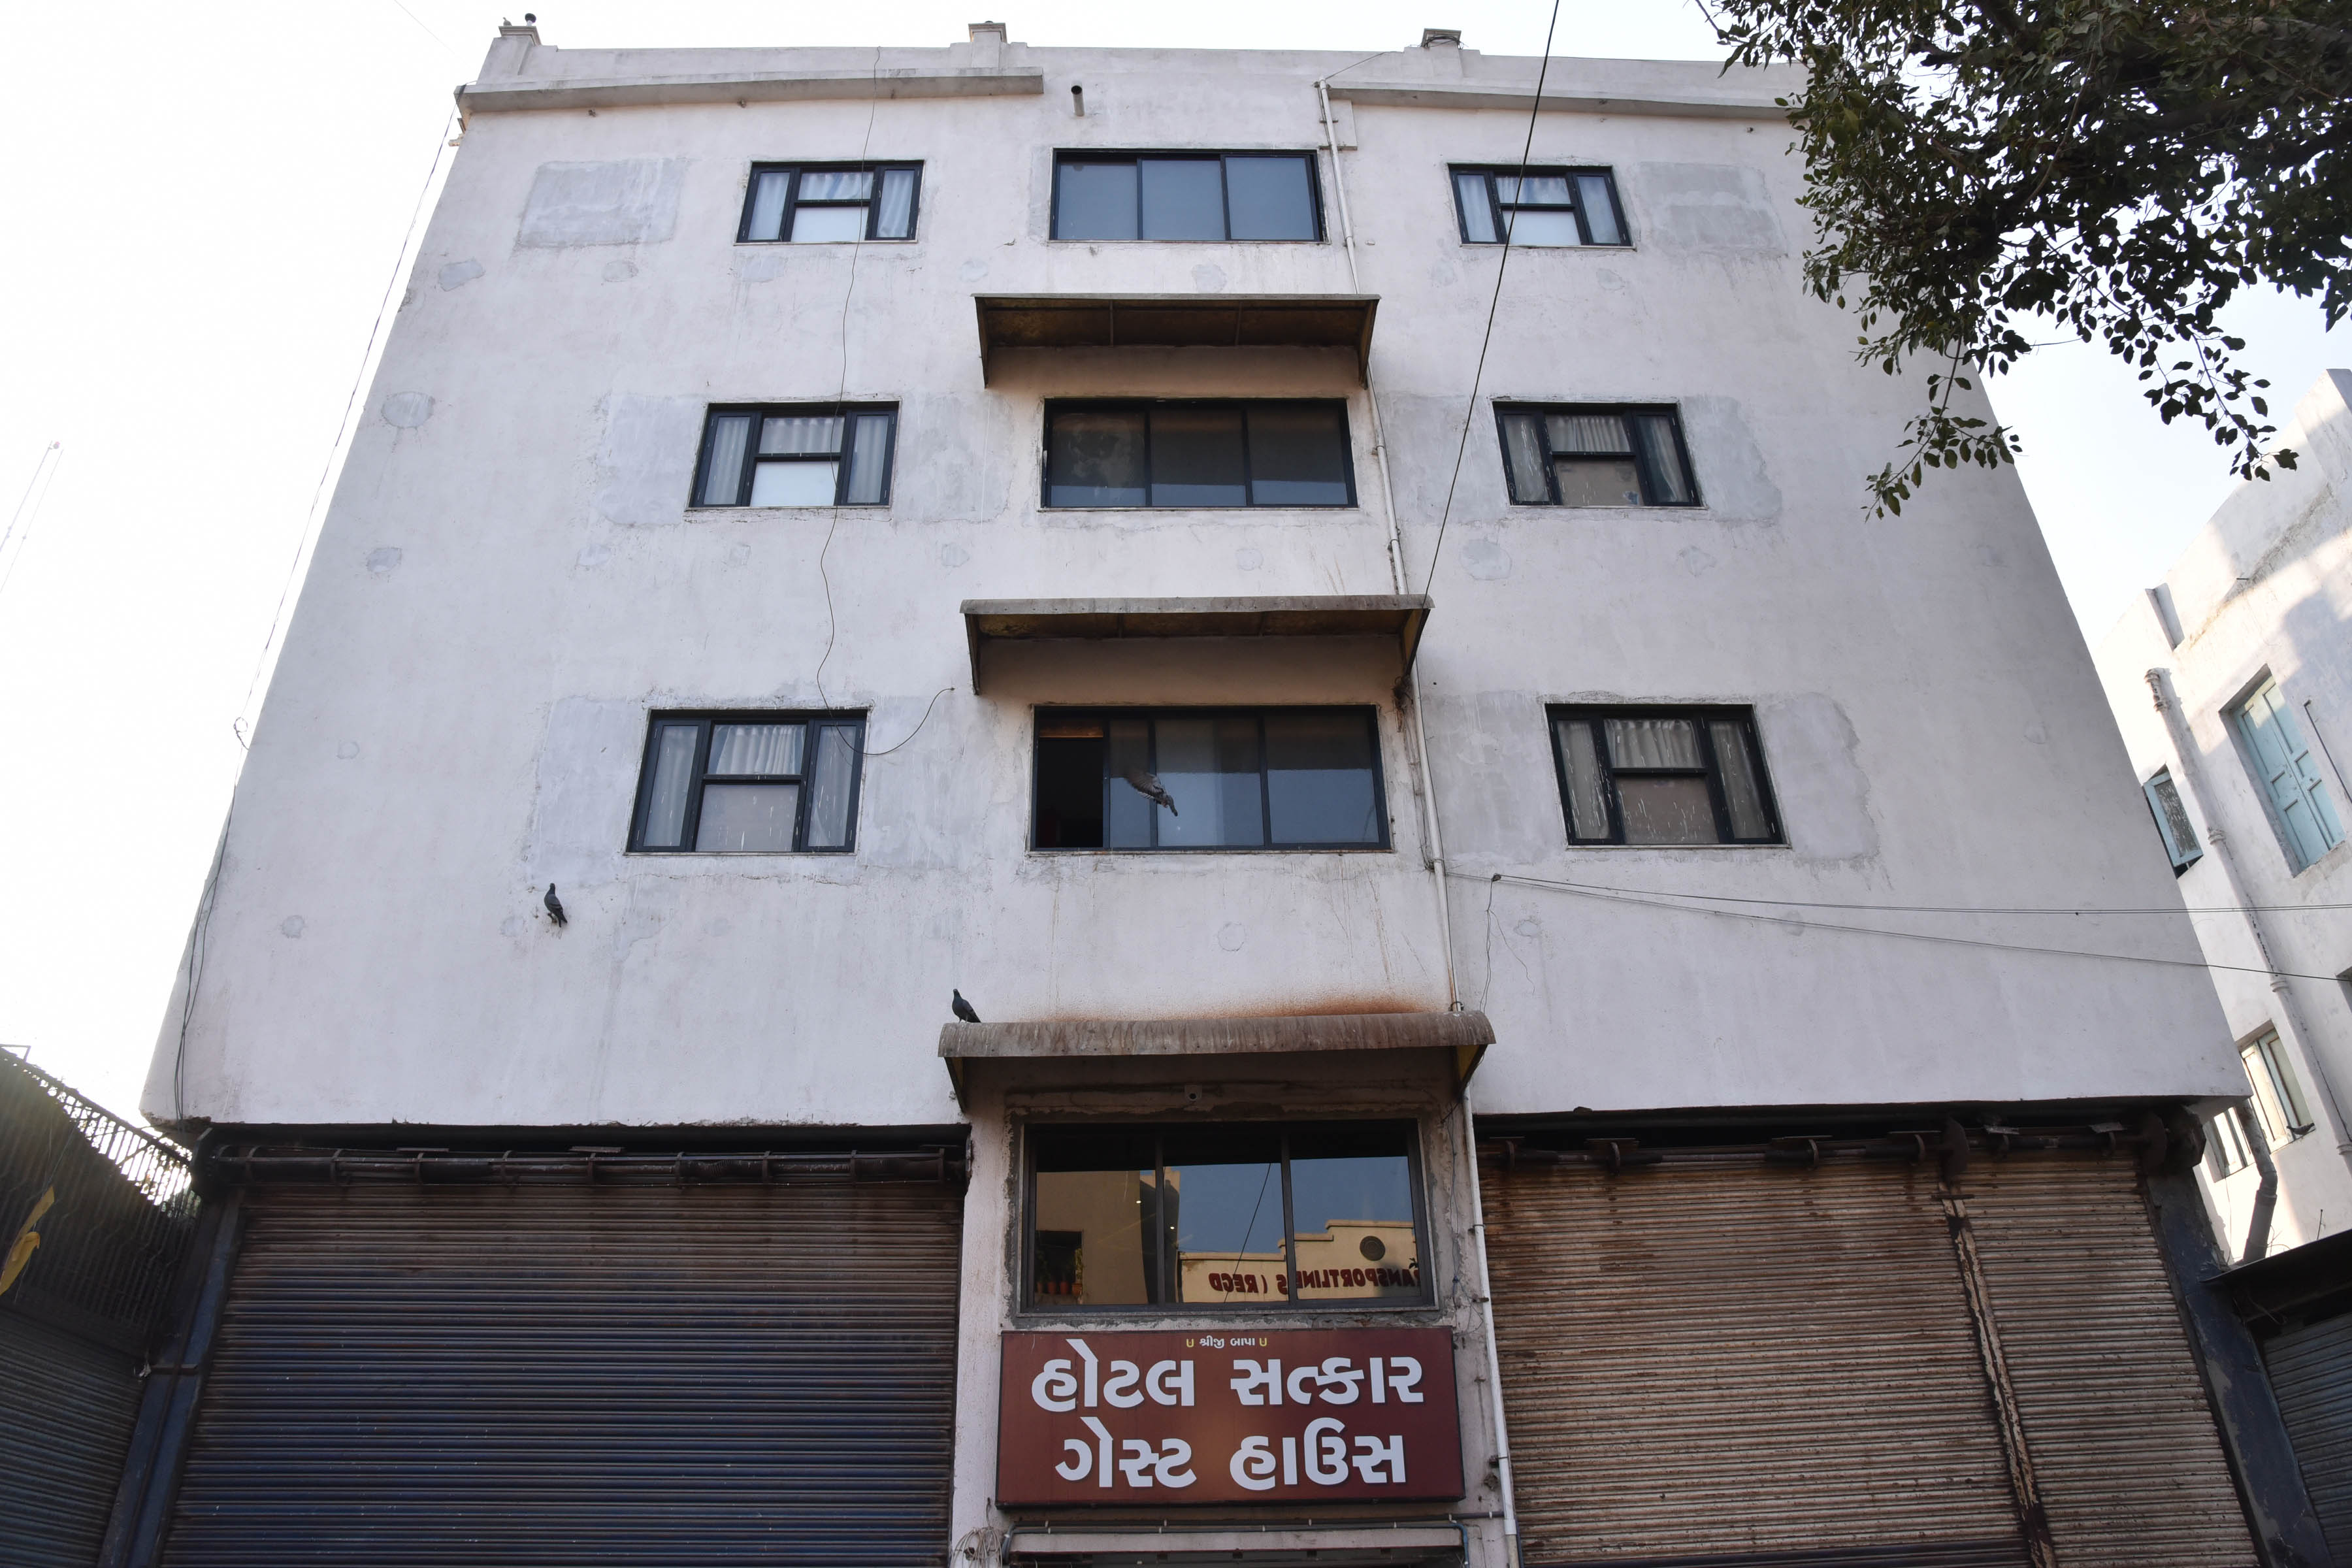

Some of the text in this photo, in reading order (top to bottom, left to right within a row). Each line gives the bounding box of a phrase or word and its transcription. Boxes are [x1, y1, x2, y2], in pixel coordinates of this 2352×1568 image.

[1031, 1339, 1424, 1413] હોટલ સત્કાર
[1199, 1335, 1256, 1349] શ્રીજી બાપા
[1054, 1416, 1406, 1491] ગેસ્ટ હાઉસ
